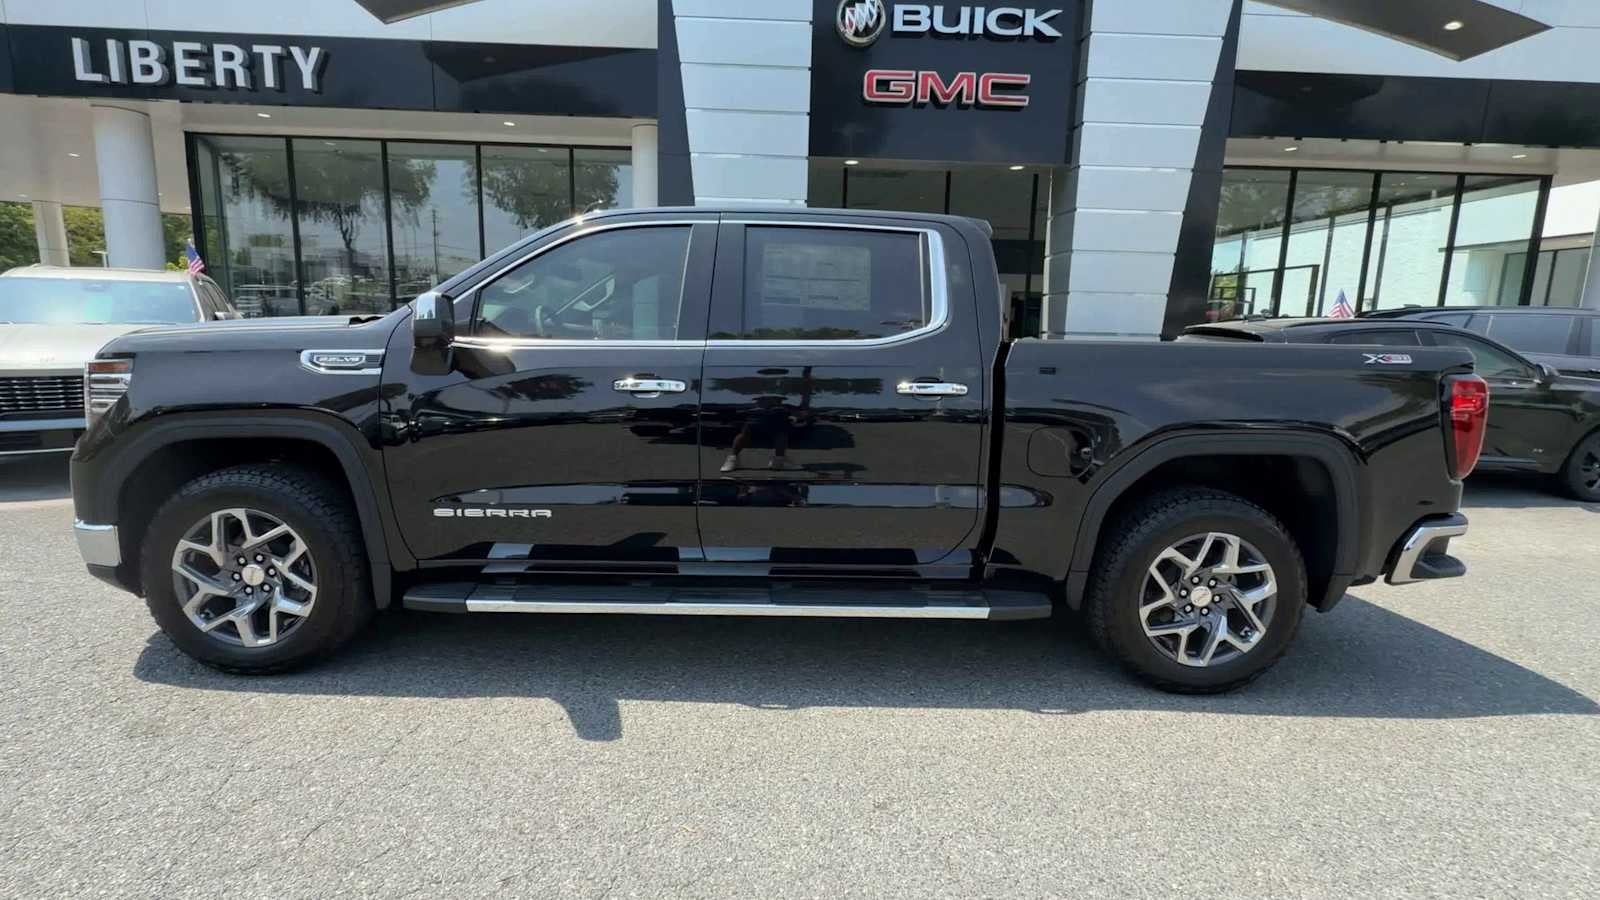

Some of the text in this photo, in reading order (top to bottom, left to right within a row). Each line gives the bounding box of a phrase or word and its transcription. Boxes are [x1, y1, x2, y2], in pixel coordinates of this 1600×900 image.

[892, 4, 1063, 38] BUICK
[71, 37, 324, 91] LIBERTY
[863, 69, 1031, 107] GMC
[432, 507, 552, 518] SIERRA
